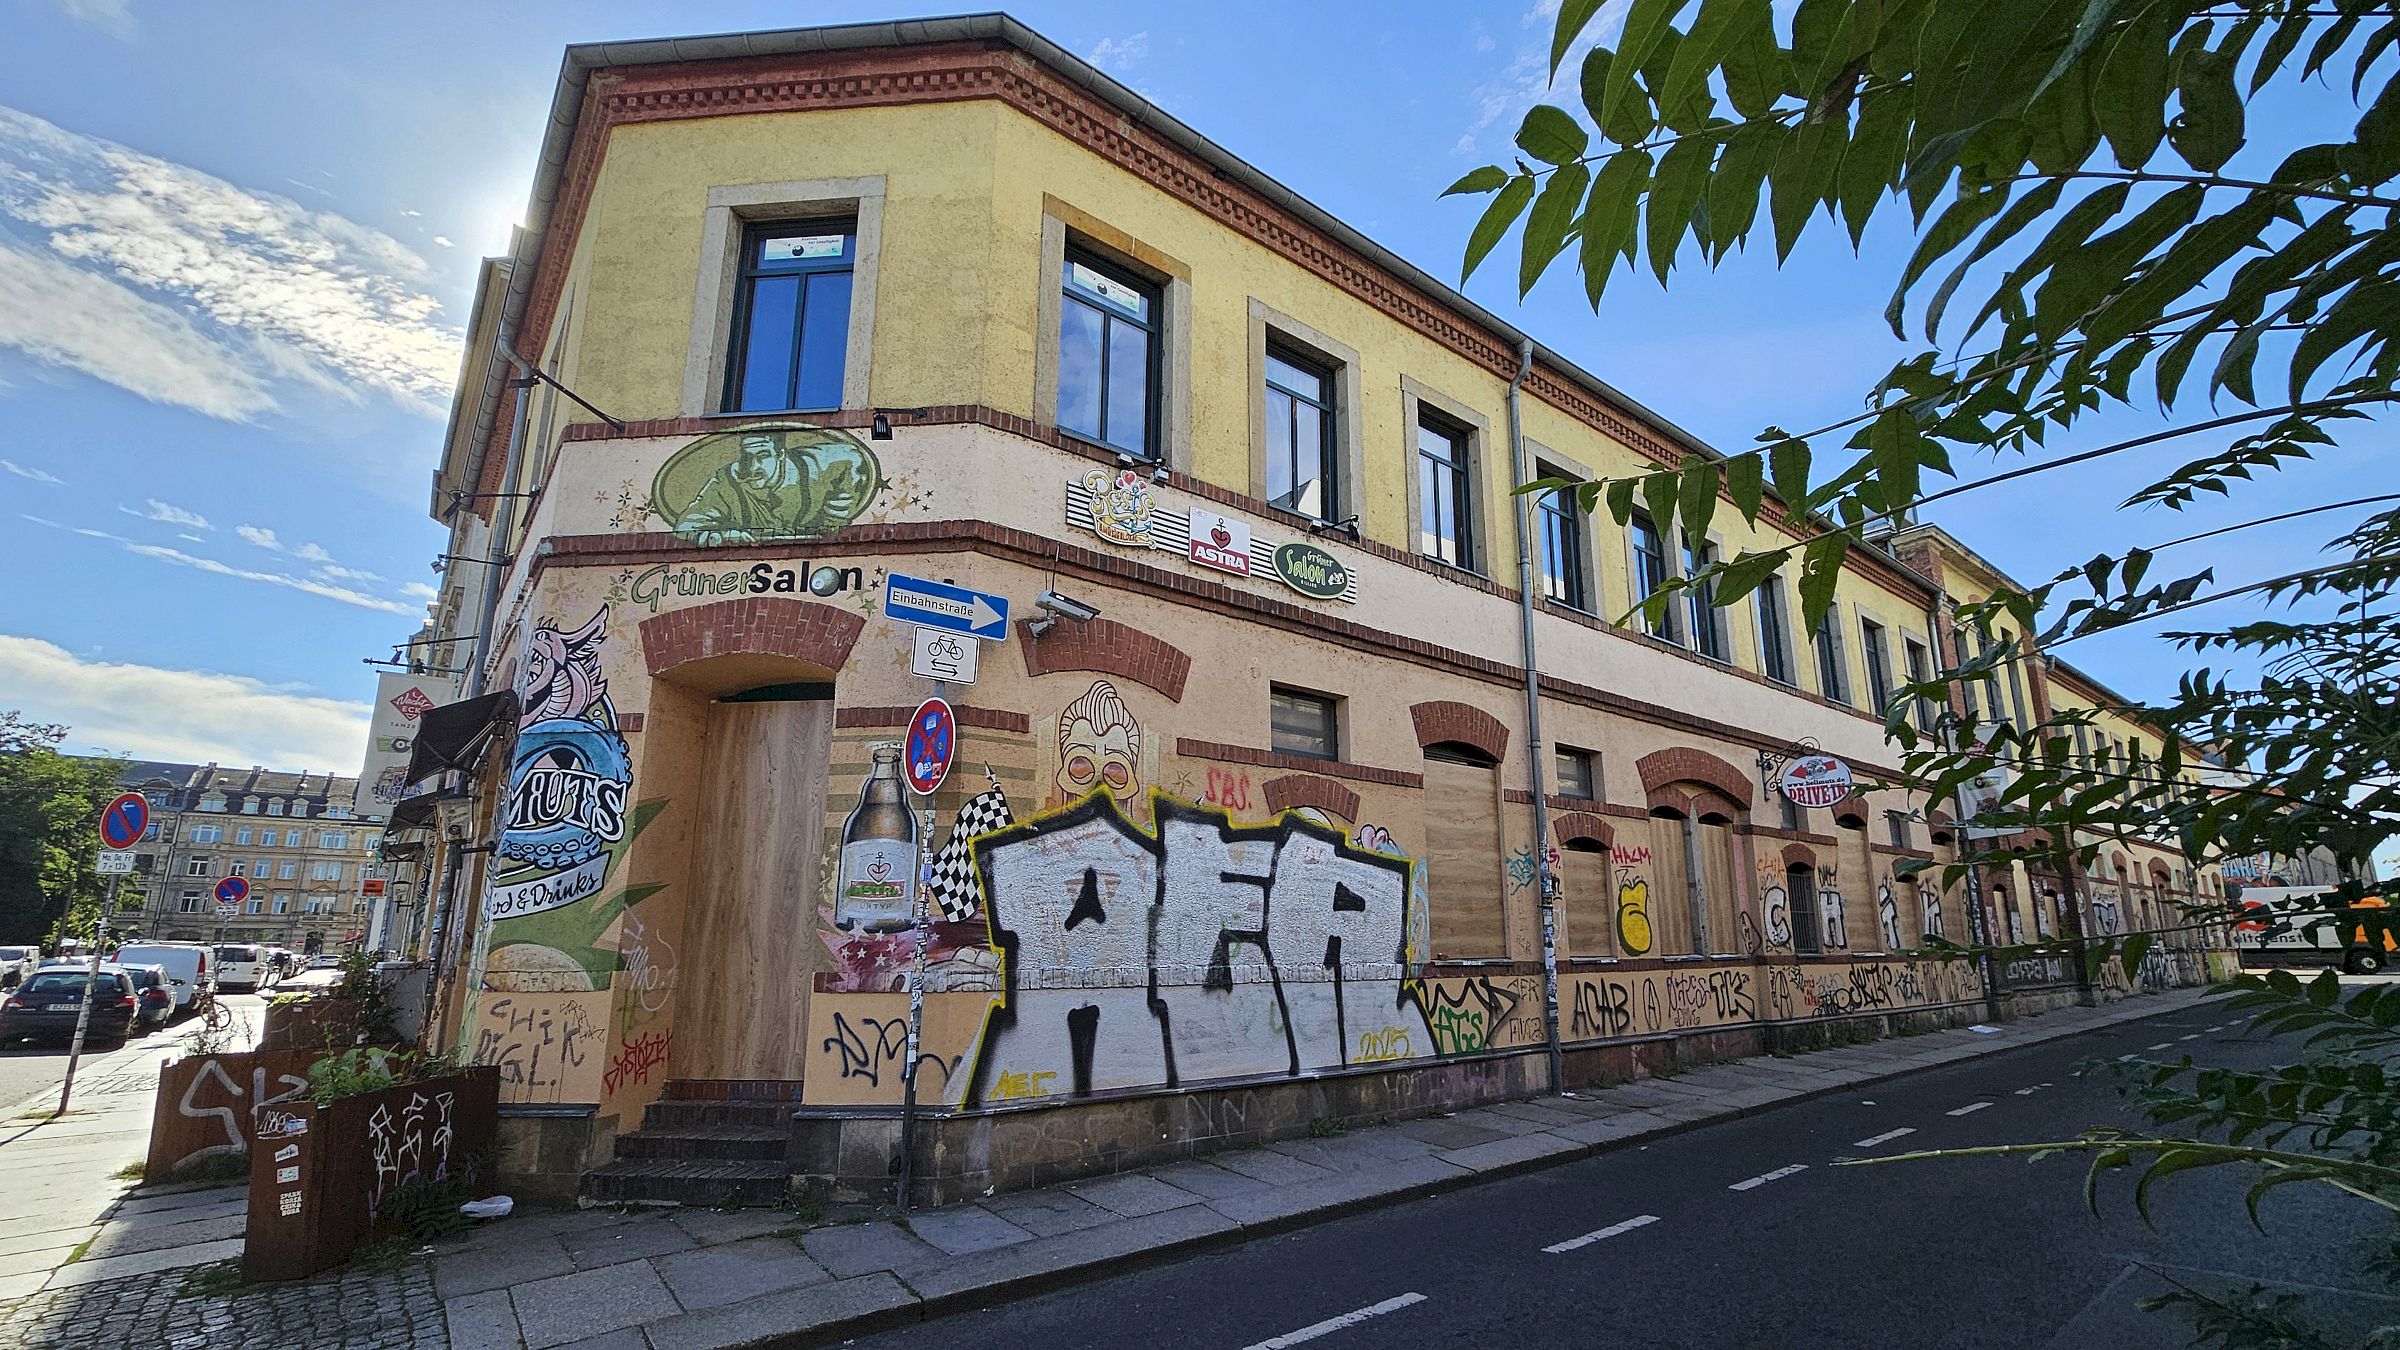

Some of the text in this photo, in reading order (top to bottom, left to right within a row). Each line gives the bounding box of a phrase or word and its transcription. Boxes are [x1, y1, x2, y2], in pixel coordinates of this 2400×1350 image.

[1195, 545, 1246, 571] ASTRA
[1287, 549, 1325, 586] Salon
[631, 561, 863, 612] Grüner Salon
[892, 589, 974, 616] Einbahnstraße
[401, 705, 421, 714] ECK
[1788, 784, 1846, 805] DRIVE IN
[518, 887, 530, 909] &
[531, 872, 599, 906] Drinks
[1571, 977, 1637, 1037] ACAB!
